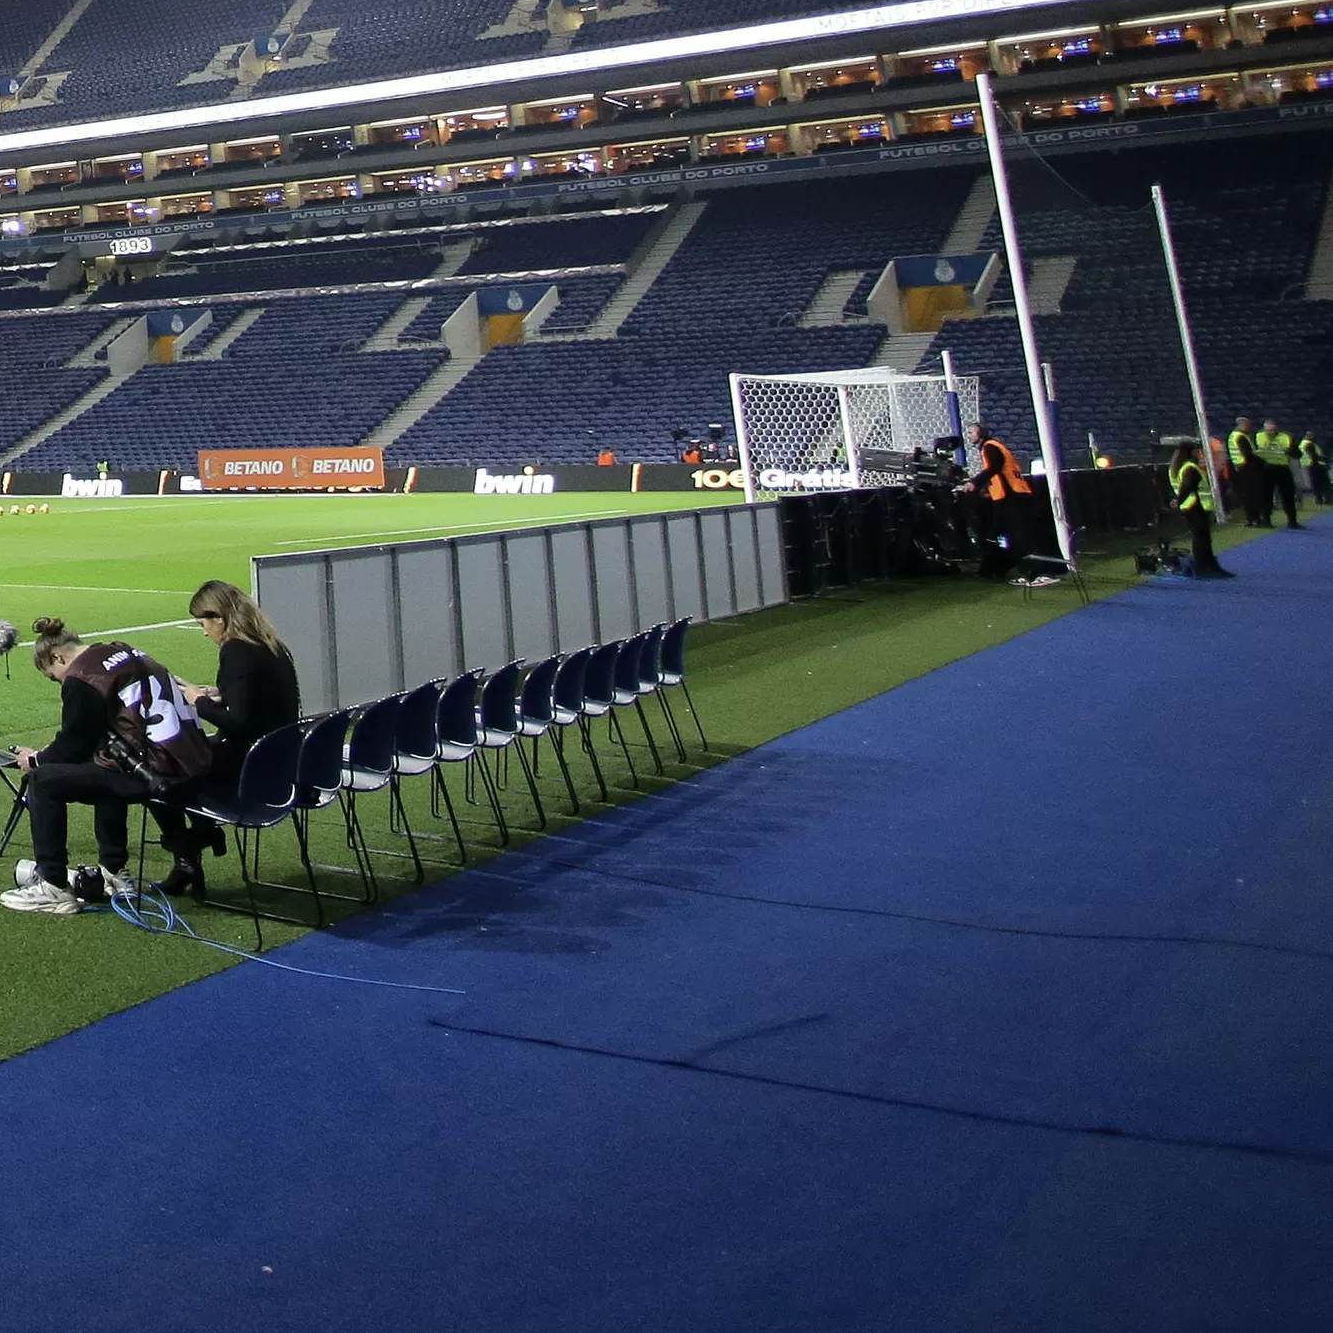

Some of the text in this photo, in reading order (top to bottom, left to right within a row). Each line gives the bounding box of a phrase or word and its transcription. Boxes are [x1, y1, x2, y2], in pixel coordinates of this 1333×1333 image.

[879, 143, 962, 160] FUTEBOL
[1035, 132, 1063, 144] DO
[1068, 124, 1139, 141] PORTO
[558, 163, 769, 192] FUTEBOL CLUBE DO PORTO
[291, 195, 467, 219] FUTEBOL CLUBE DO PORTO
[63, 222, 215, 242] FUTEBOL CLUBE DO PORTO
[109, 237, 152, 255] 1893
[223, 460, 283, 476] BETANO
[313, 458, 374, 474] BETANO
[61, 472, 123, 496] bwin
[473, 466, 554, 494] bwin
